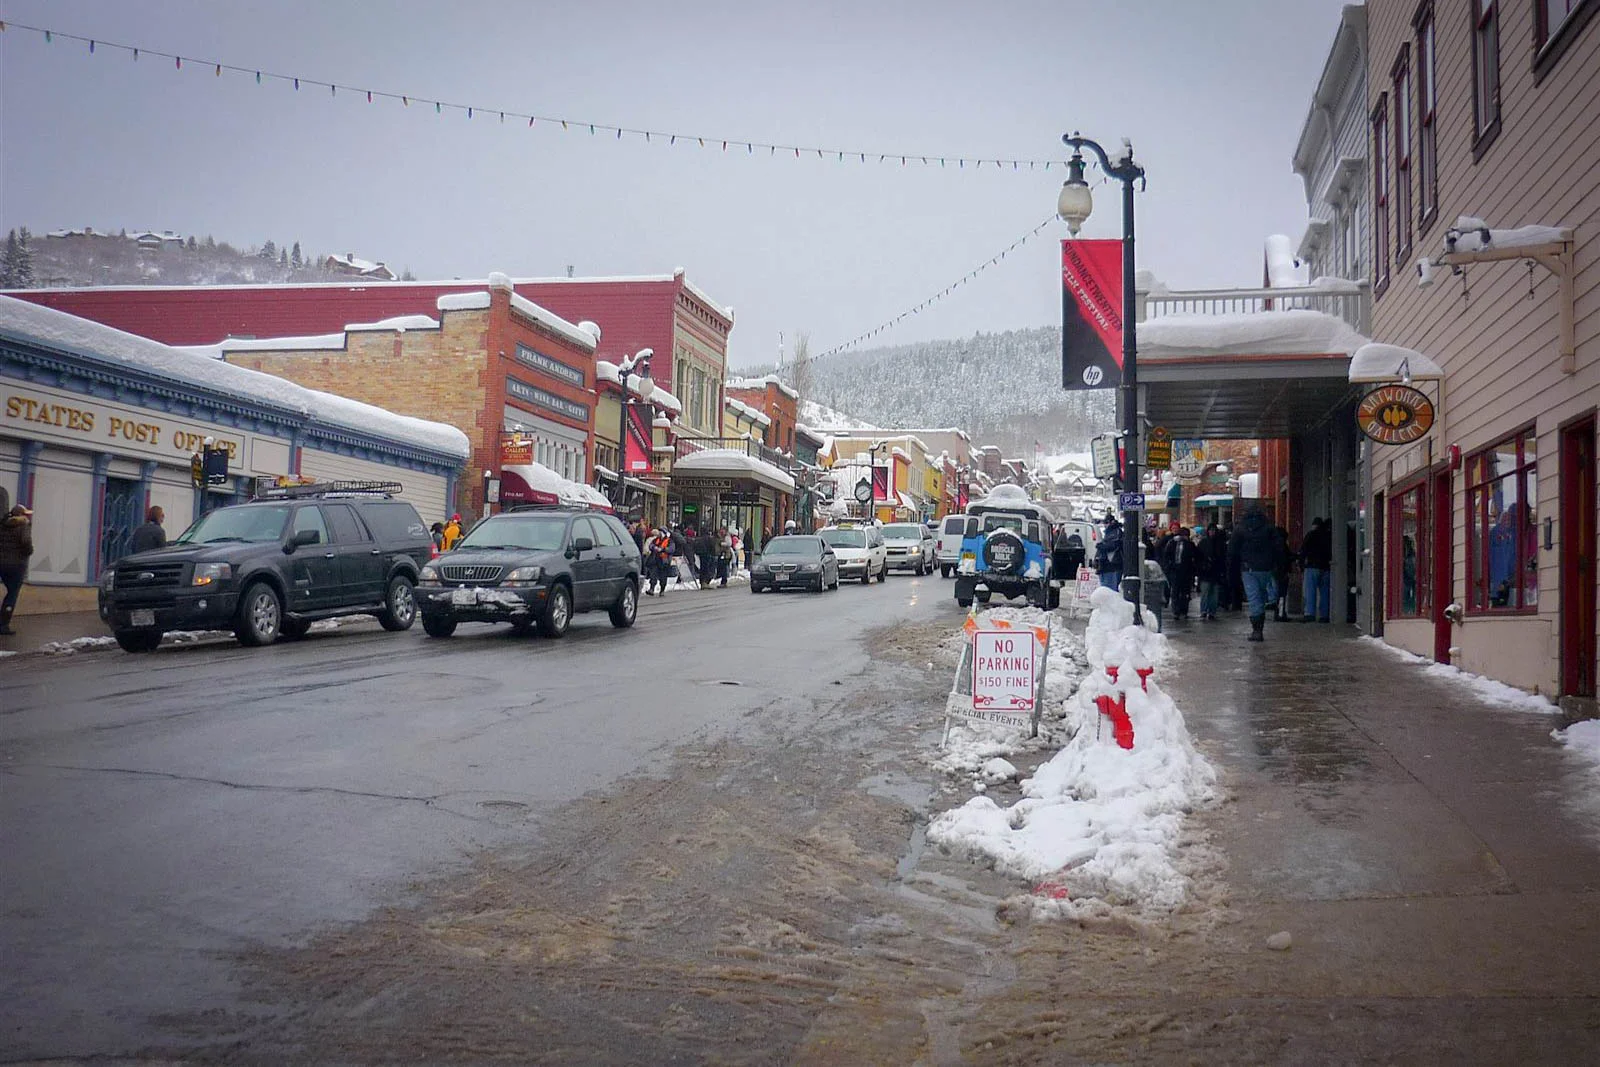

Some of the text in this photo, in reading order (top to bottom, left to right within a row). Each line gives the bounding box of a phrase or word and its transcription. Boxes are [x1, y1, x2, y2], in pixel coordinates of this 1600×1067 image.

[1077, 288, 1109, 331] FESTIVAL
[520, 348, 579, 382] FRANK ANDREW
[1086, 366, 1100, 385] hp
[6, 396, 95, 432] STATES
[108, 416, 161, 445] POST
[1367, 419, 1424, 442] GALLERY
[994, 639, 1014, 653] NO
[979, 657, 1029, 671] PARKING
[979, 676, 1029, 687] $150 FINE
[951, 704, 1024, 727] SPECIAL EVENTS
